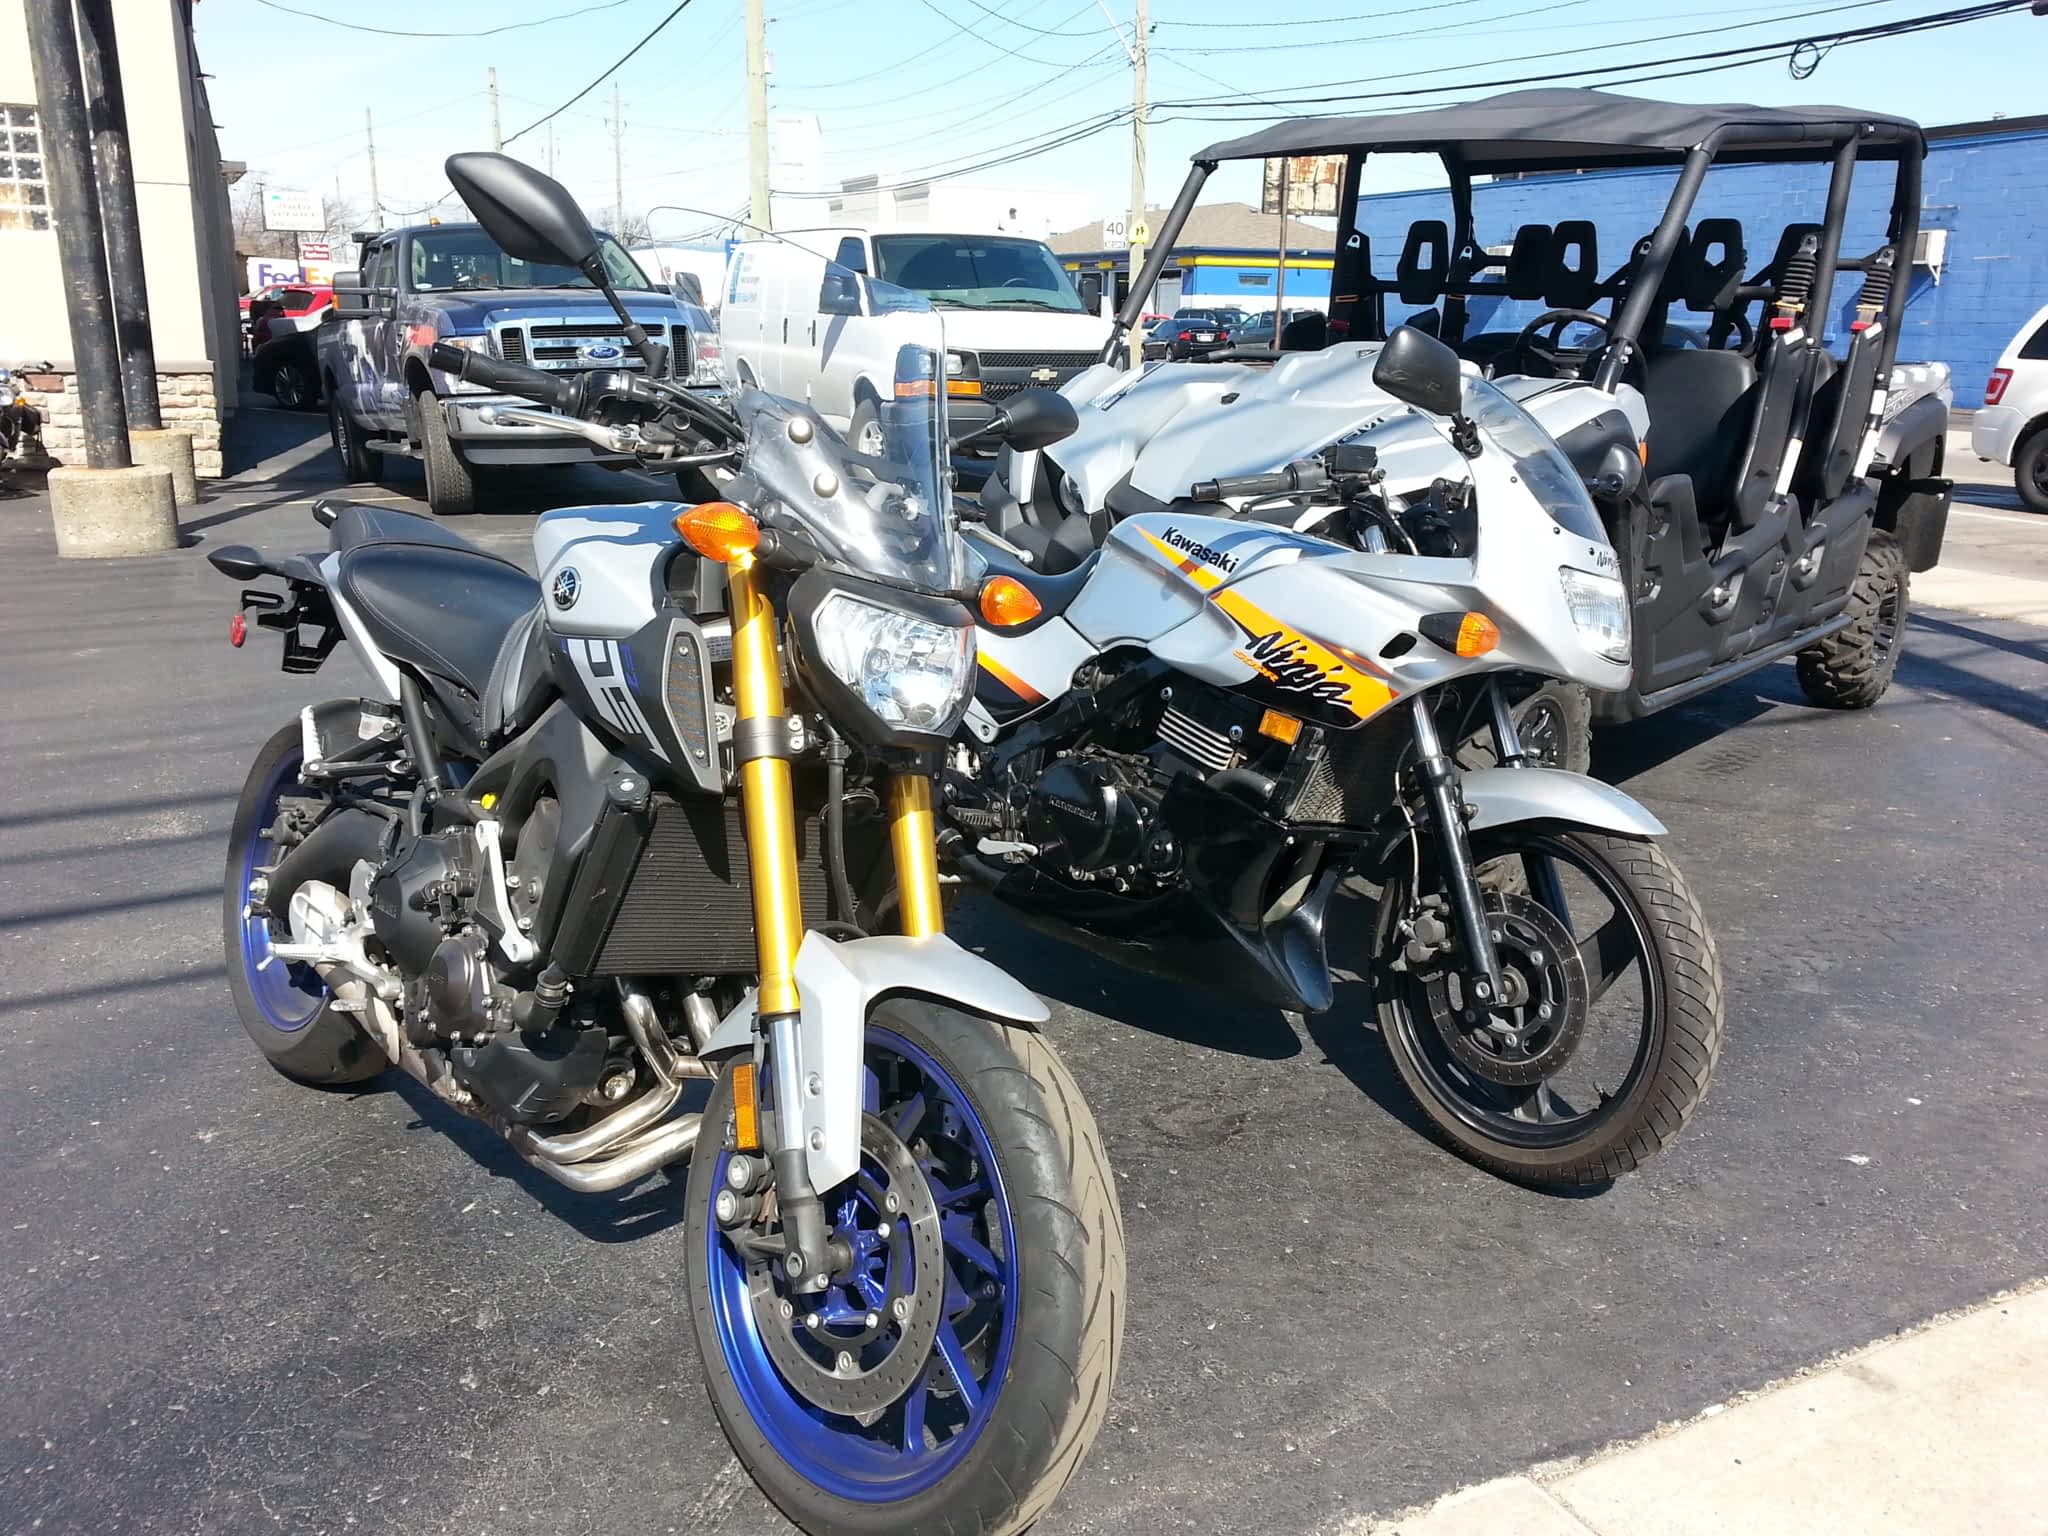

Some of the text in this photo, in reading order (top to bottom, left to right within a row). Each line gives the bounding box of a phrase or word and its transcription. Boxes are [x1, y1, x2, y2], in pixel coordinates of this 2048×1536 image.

[1106, 222, 1123, 235] 40
[593, 346, 613, 357] Ford
[1161, 526, 1239, 573] Kawasaki
[1244, 630, 1352, 706] Ninja
